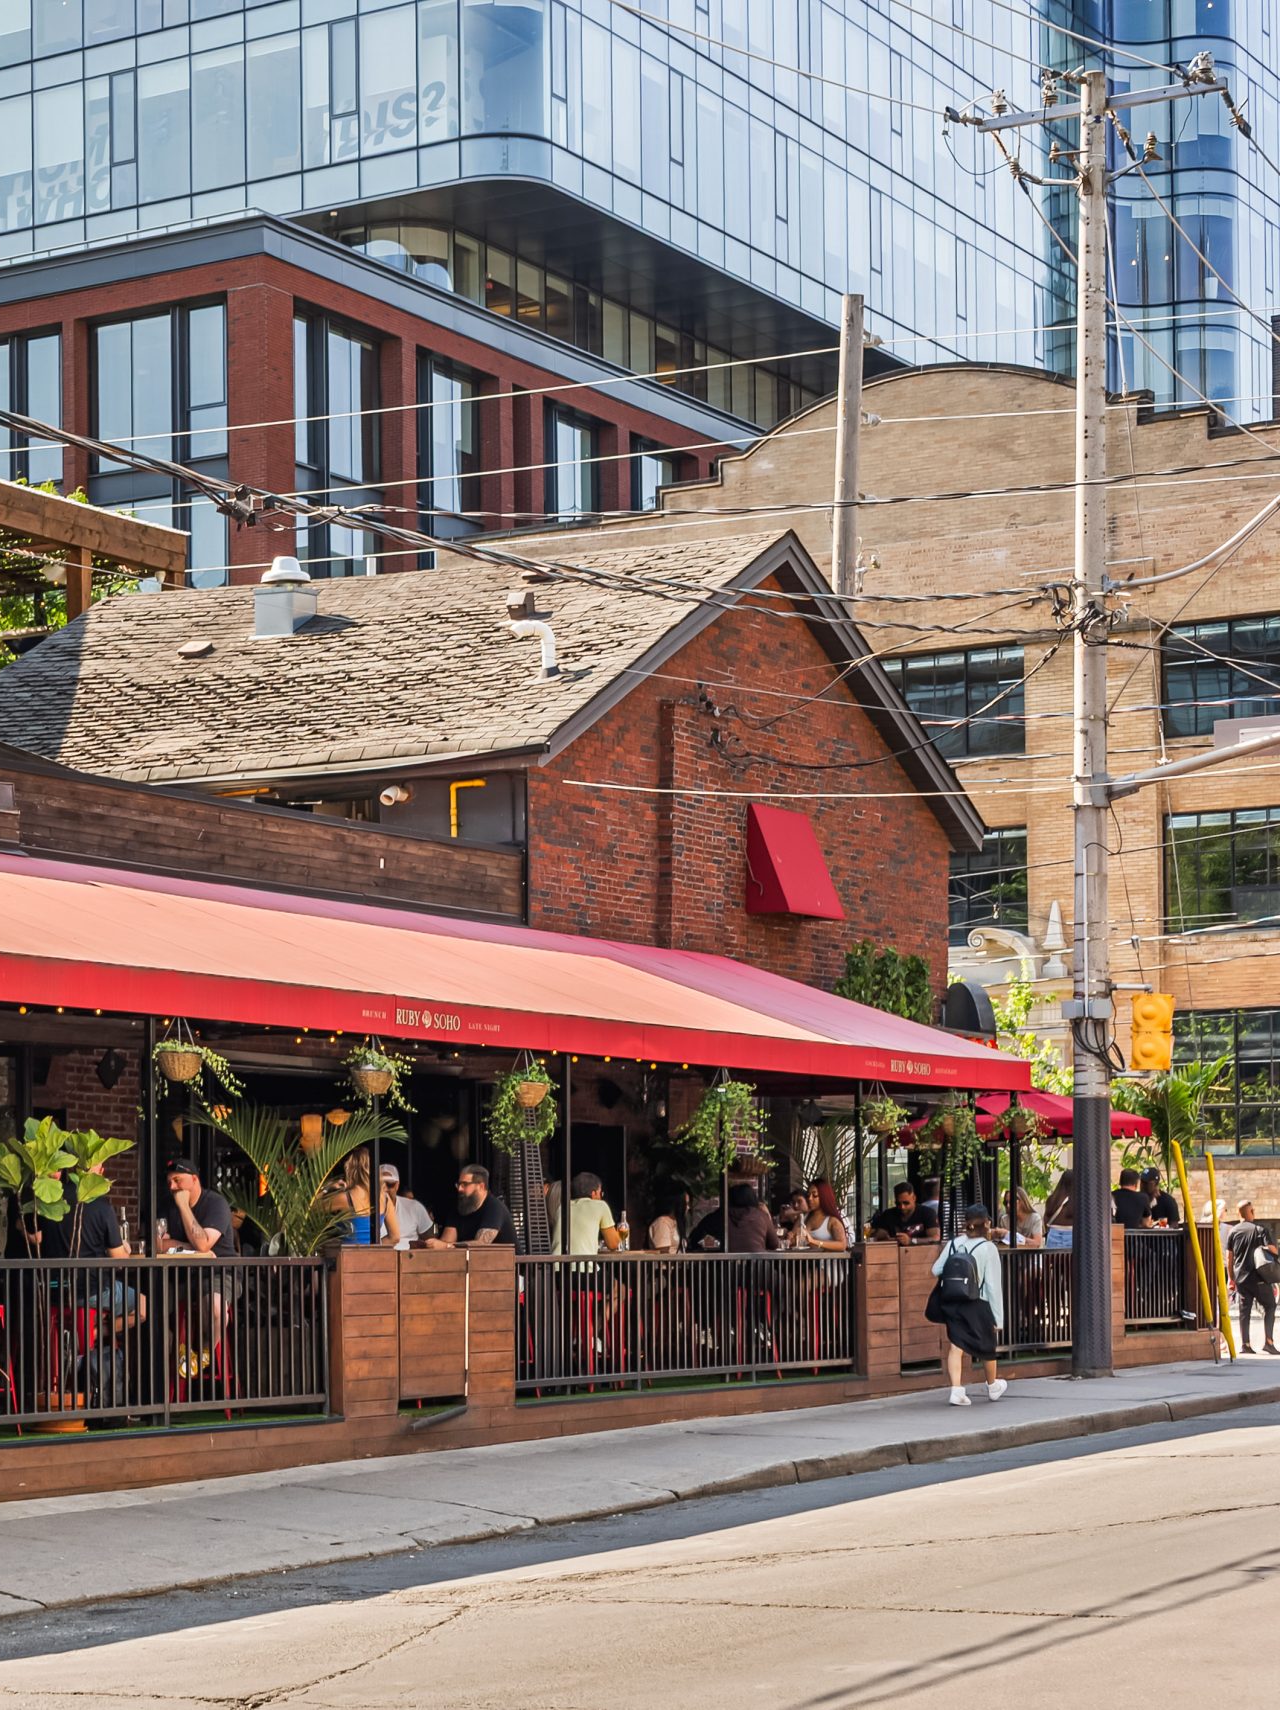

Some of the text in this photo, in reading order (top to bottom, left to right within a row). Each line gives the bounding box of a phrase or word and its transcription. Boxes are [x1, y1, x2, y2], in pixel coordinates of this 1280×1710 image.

[396, 1008, 420, 1027] RUBY
[434, 1013, 461, 1031] SOHO
[890, 1059, 906, 1073] RUBY
[914, 1062, 931, 1076] SOHO
